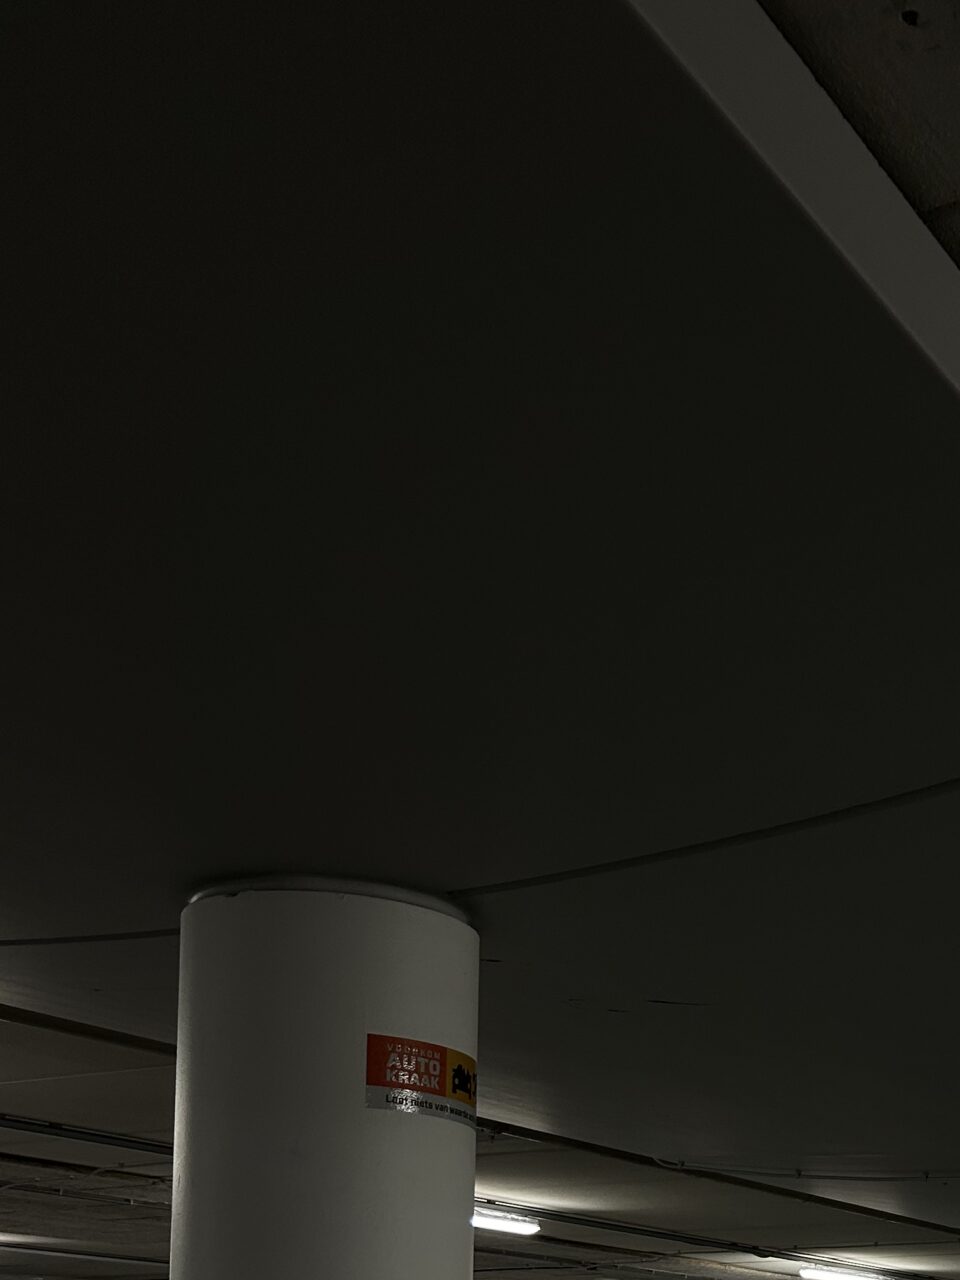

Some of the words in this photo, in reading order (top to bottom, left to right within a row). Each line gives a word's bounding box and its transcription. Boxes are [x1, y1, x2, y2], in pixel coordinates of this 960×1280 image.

[386, 1053, 441, 1075] AUTO
[386, 1069, 440, 1090] KRAAK
[386, 1094, 408, 1106] Laat
[411, 1098, 433, 1110] niets
[434, 1103, 448, 1113] van
